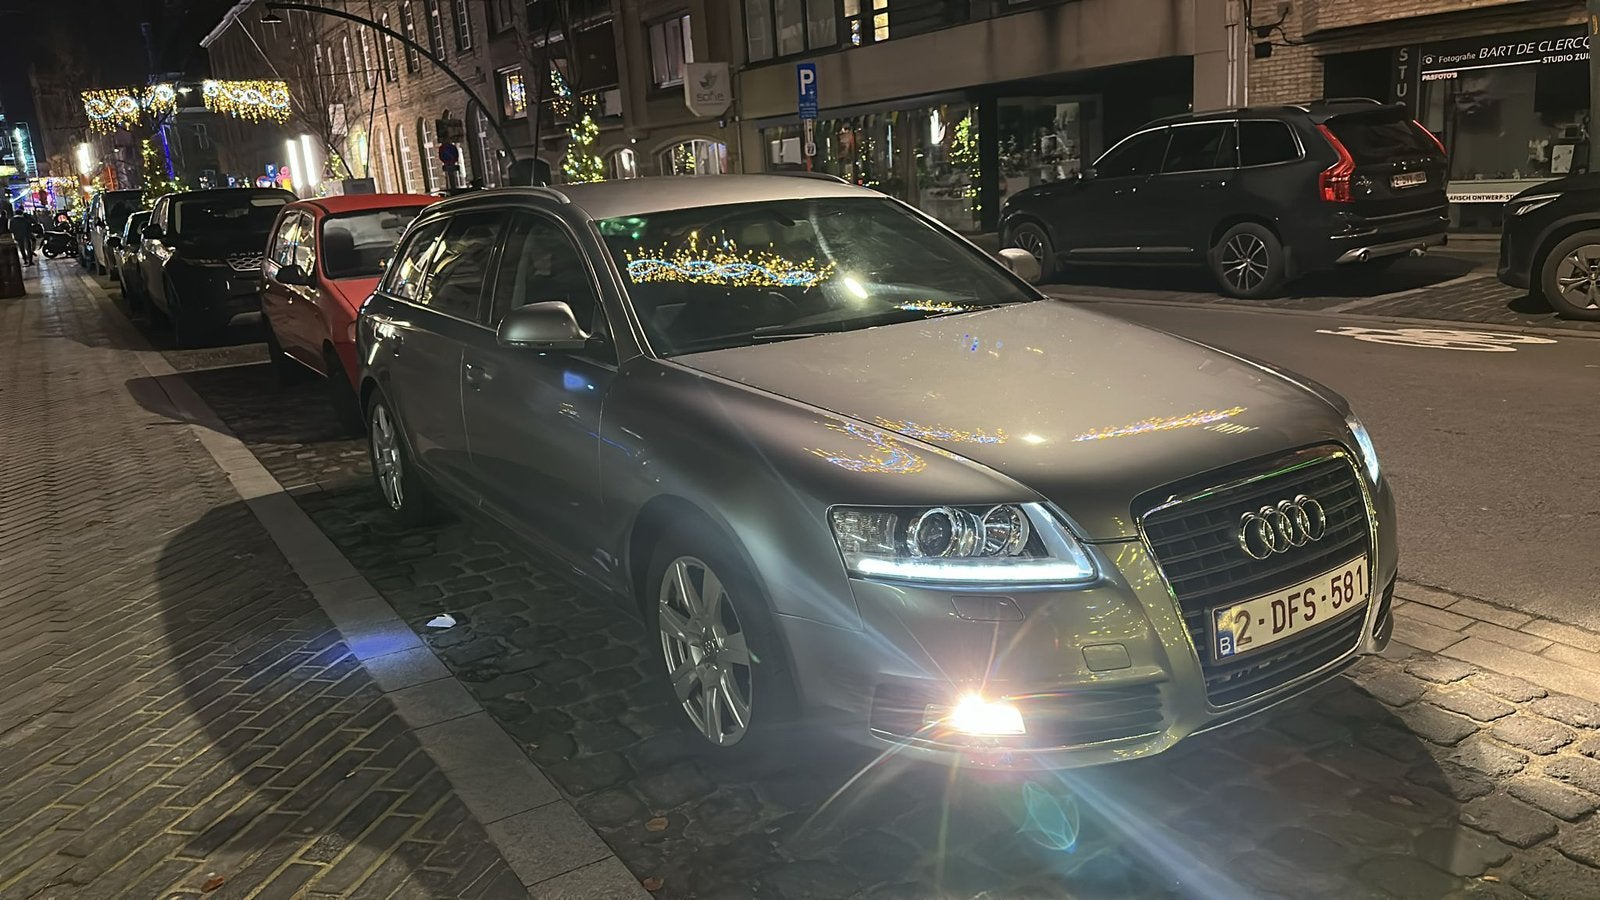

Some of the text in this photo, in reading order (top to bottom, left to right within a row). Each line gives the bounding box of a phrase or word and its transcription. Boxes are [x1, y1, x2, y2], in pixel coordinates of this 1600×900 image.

[1439, 52, 1476, 63] Fotografie
[1479, 44, 1515, 59] BART
[1516, 42, 1536, 55] DE
[1542, 52, 1590, 64] STUDIO ZUI
[800, 69, 814, 95] P
[1220, 565, 1363, 652] B 2-DFS-581
